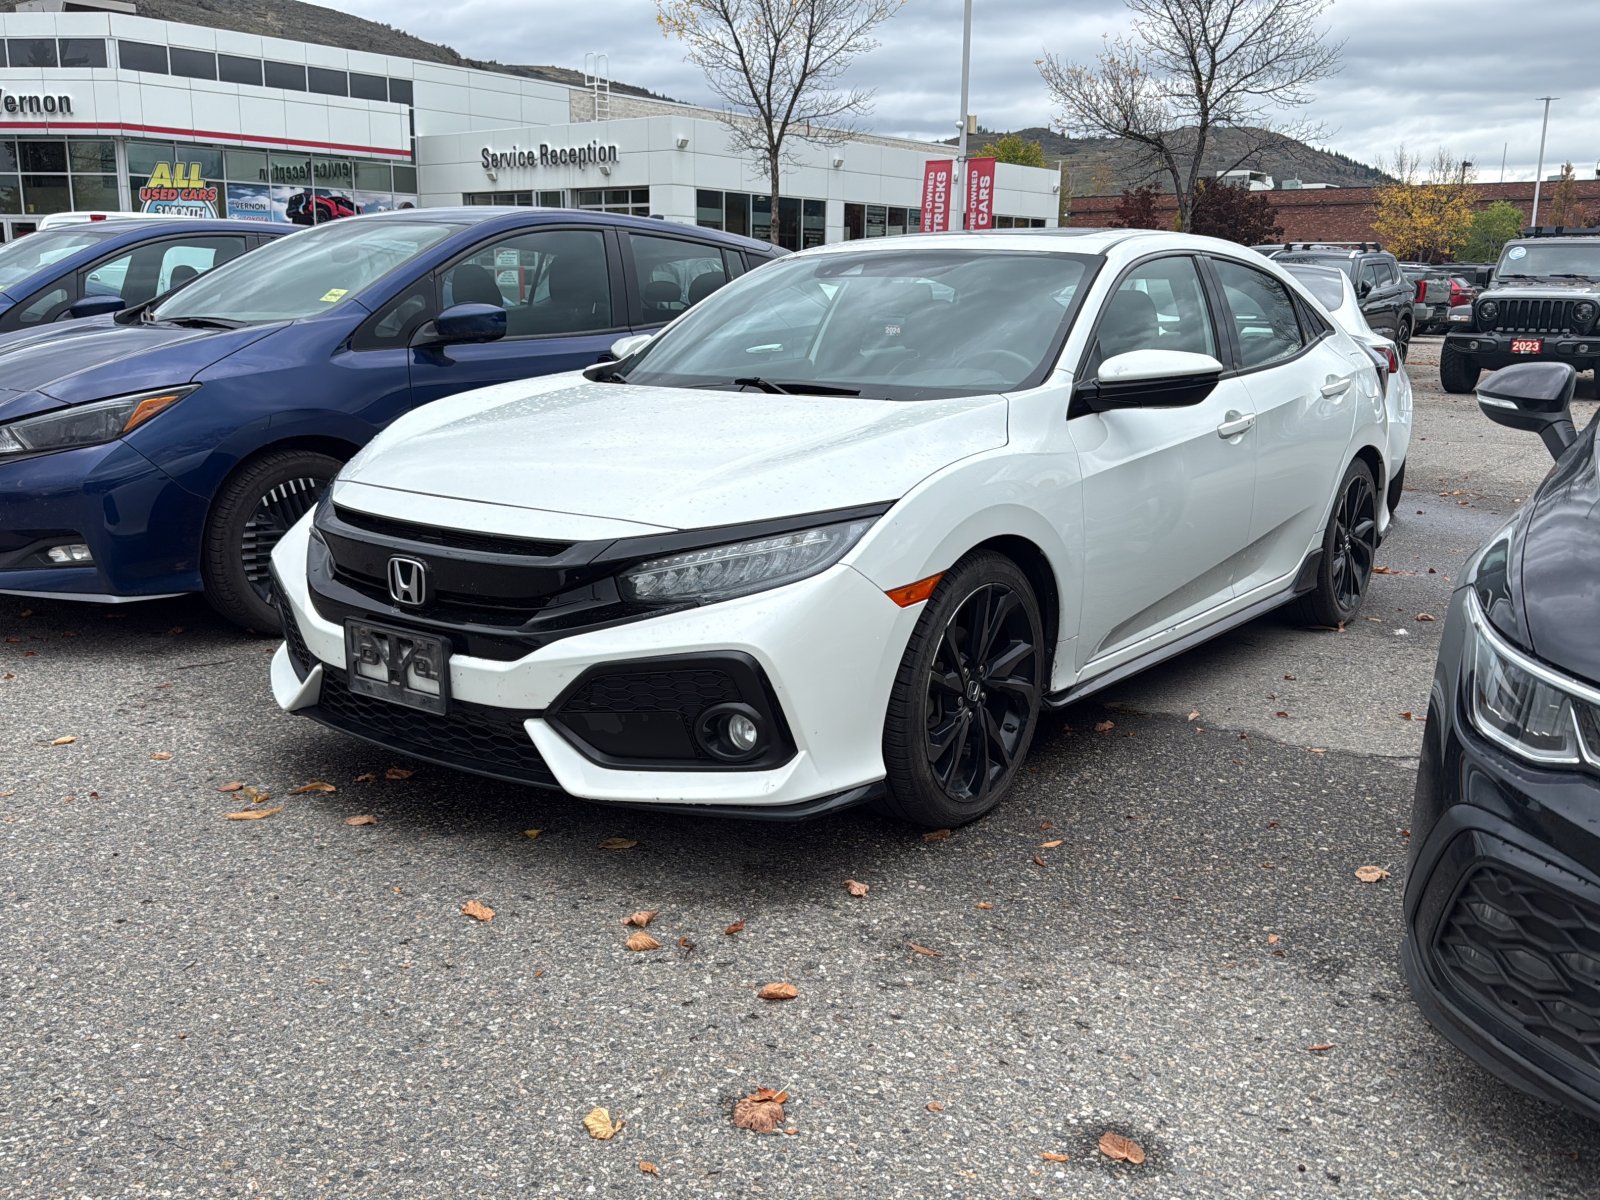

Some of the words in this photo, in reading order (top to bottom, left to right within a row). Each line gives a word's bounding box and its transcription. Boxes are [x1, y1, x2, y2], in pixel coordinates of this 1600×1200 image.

[0, 88, 73, 114] ernon
[481, 145, 536, 169] Service
[539, 140, 617, 170] Reception
[147, 162, 206, 189] ALL
[141, 188, 179, 202] USED
[180, 188, 217, 202] CARS
[234, 202, 267, 210] VERNON
[924, 171, 936, 232] PRE-OWNED
[933, 171, 947, 232] TRUCKS
[969, 170, 979, 231] PRE-OWNED
[977, 175, 991, 225] CARS
[156, 205, 164, 215] 3
[164, 205, 206, 219] MONTH
[1512, 341, 1539, 351] 2023
